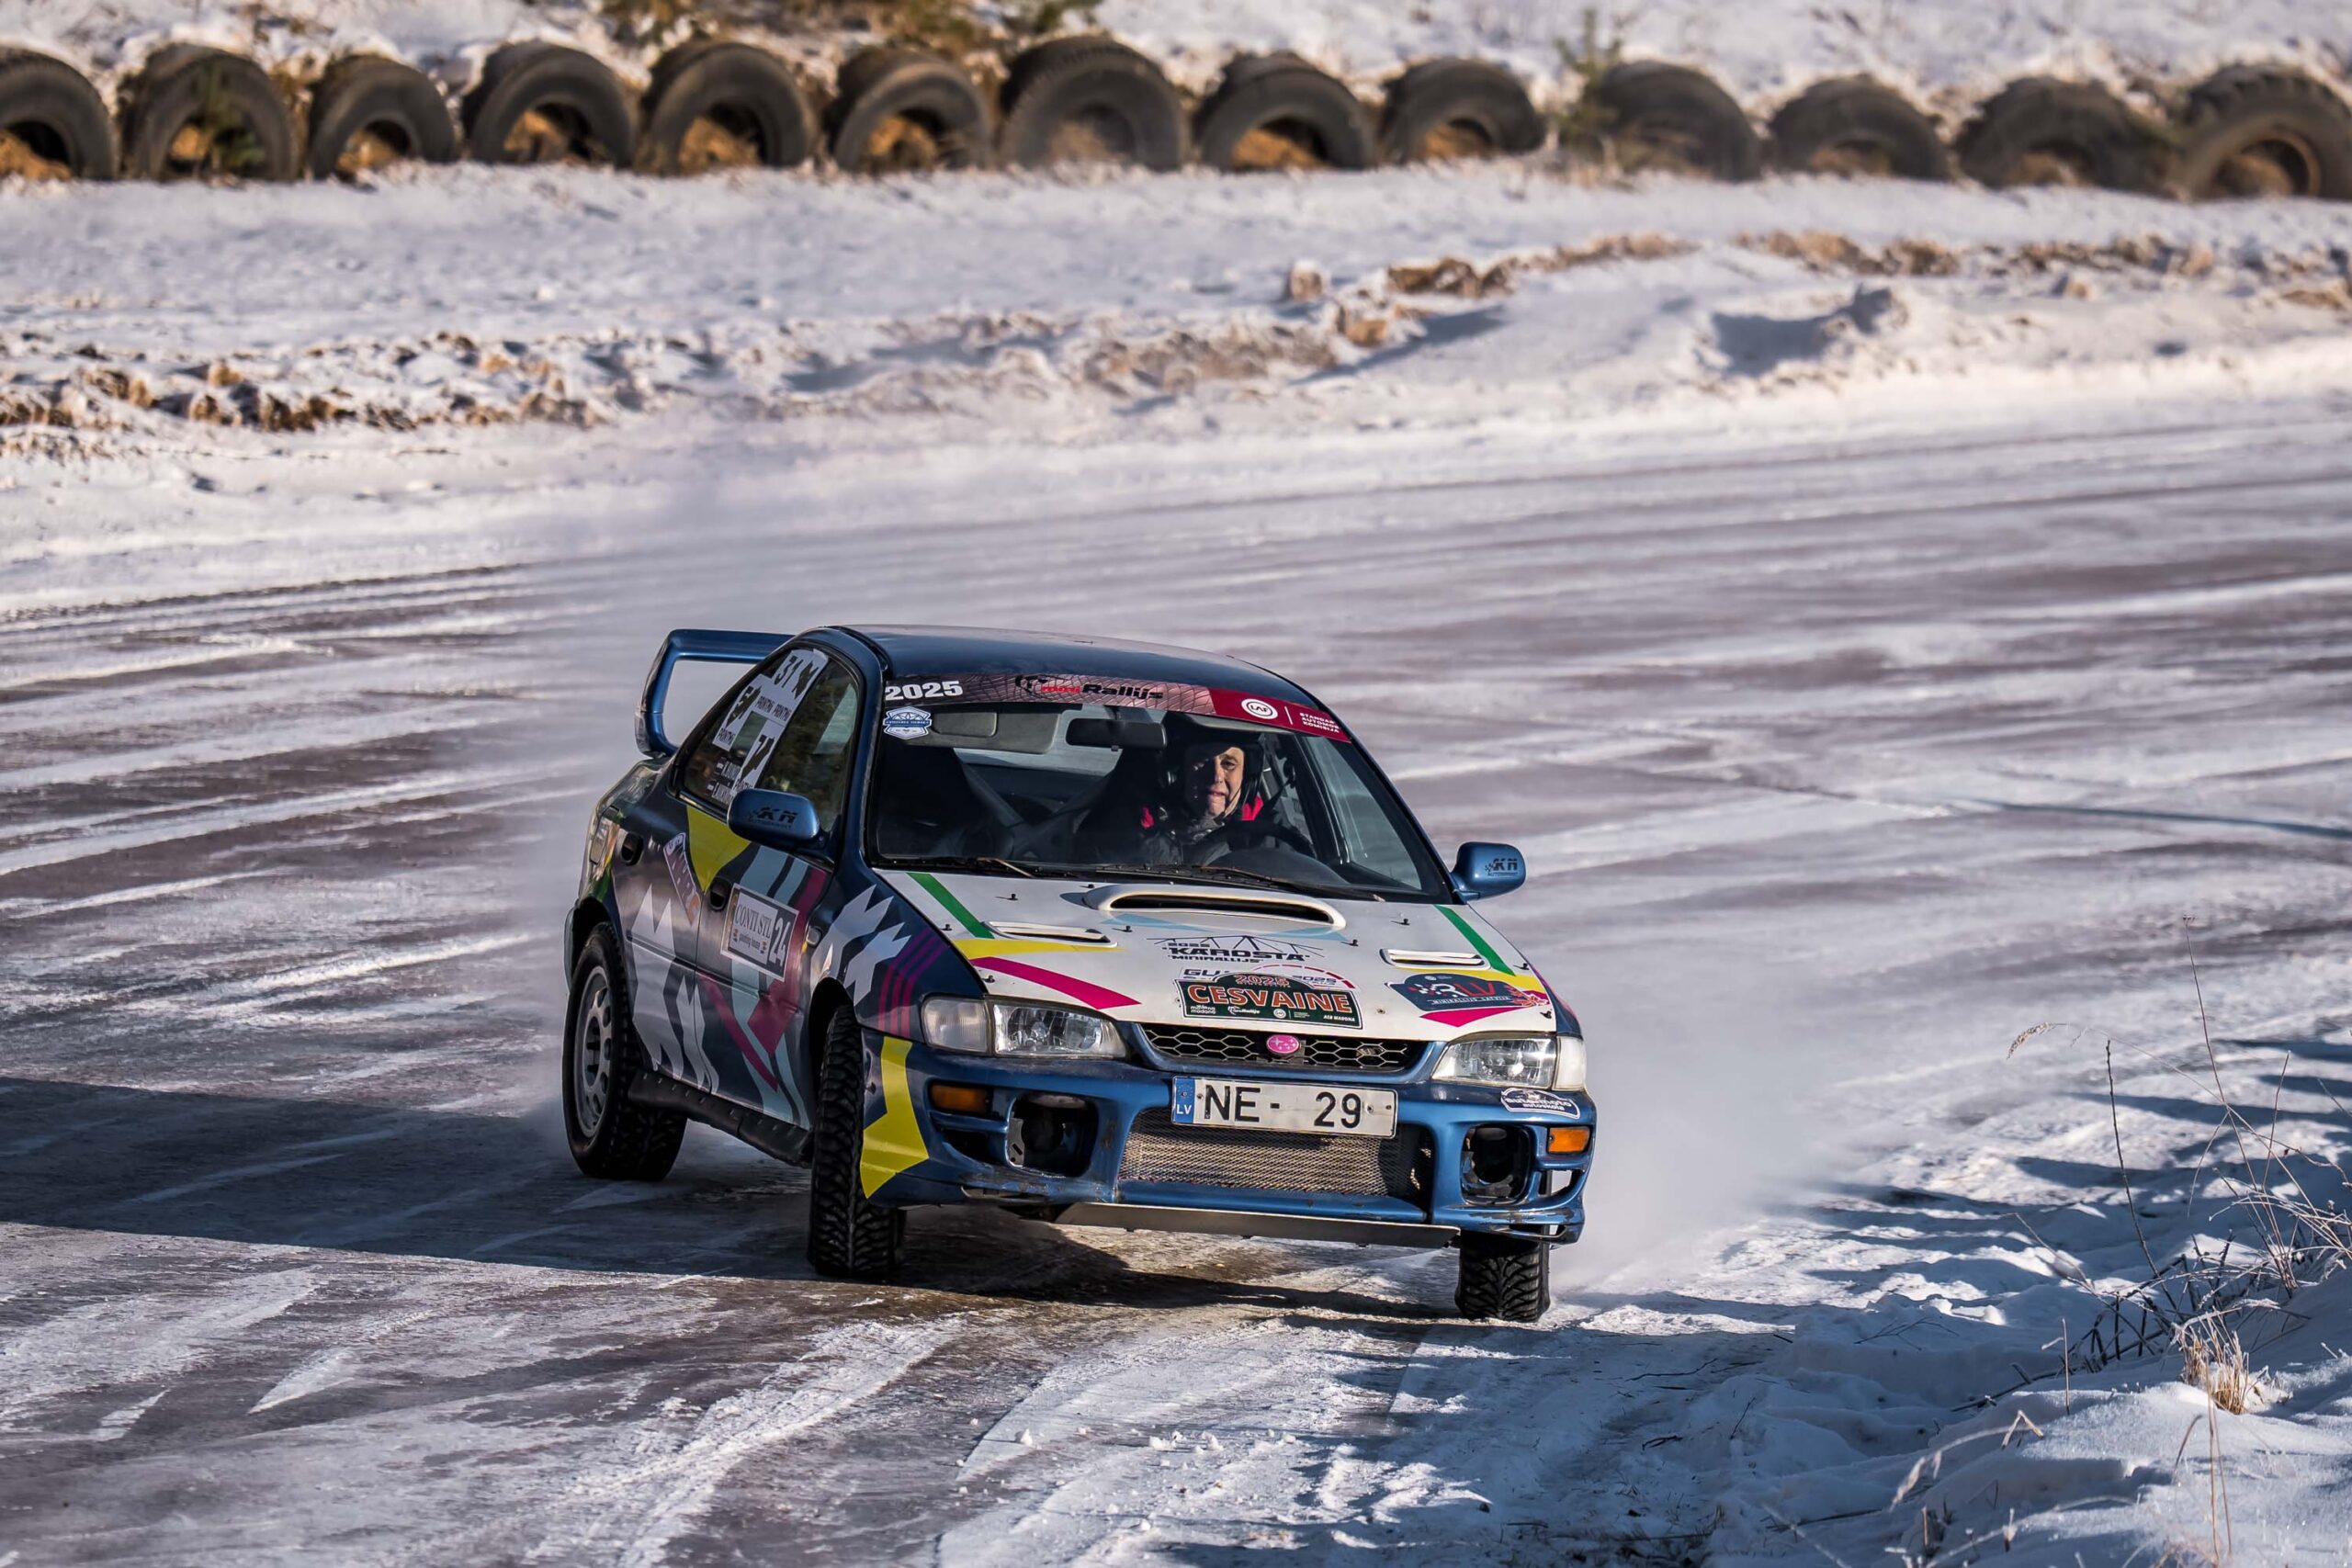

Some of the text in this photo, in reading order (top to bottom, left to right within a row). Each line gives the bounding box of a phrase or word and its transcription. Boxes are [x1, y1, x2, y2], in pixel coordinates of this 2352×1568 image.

[885, 681, 963, 701] 2025
[736, 904, 759, 932] CONTI
[769, 917, 791, 967] 24
[1169, 947, 1306, 962] KAROSTA
[1233, 974, 1291, 987] 2025
[1187, 984, 1353, 1014] CESVAINE
[1176, 1104, 1192, 1115] LV
[1314, 1091, 1363, 1129] 29
